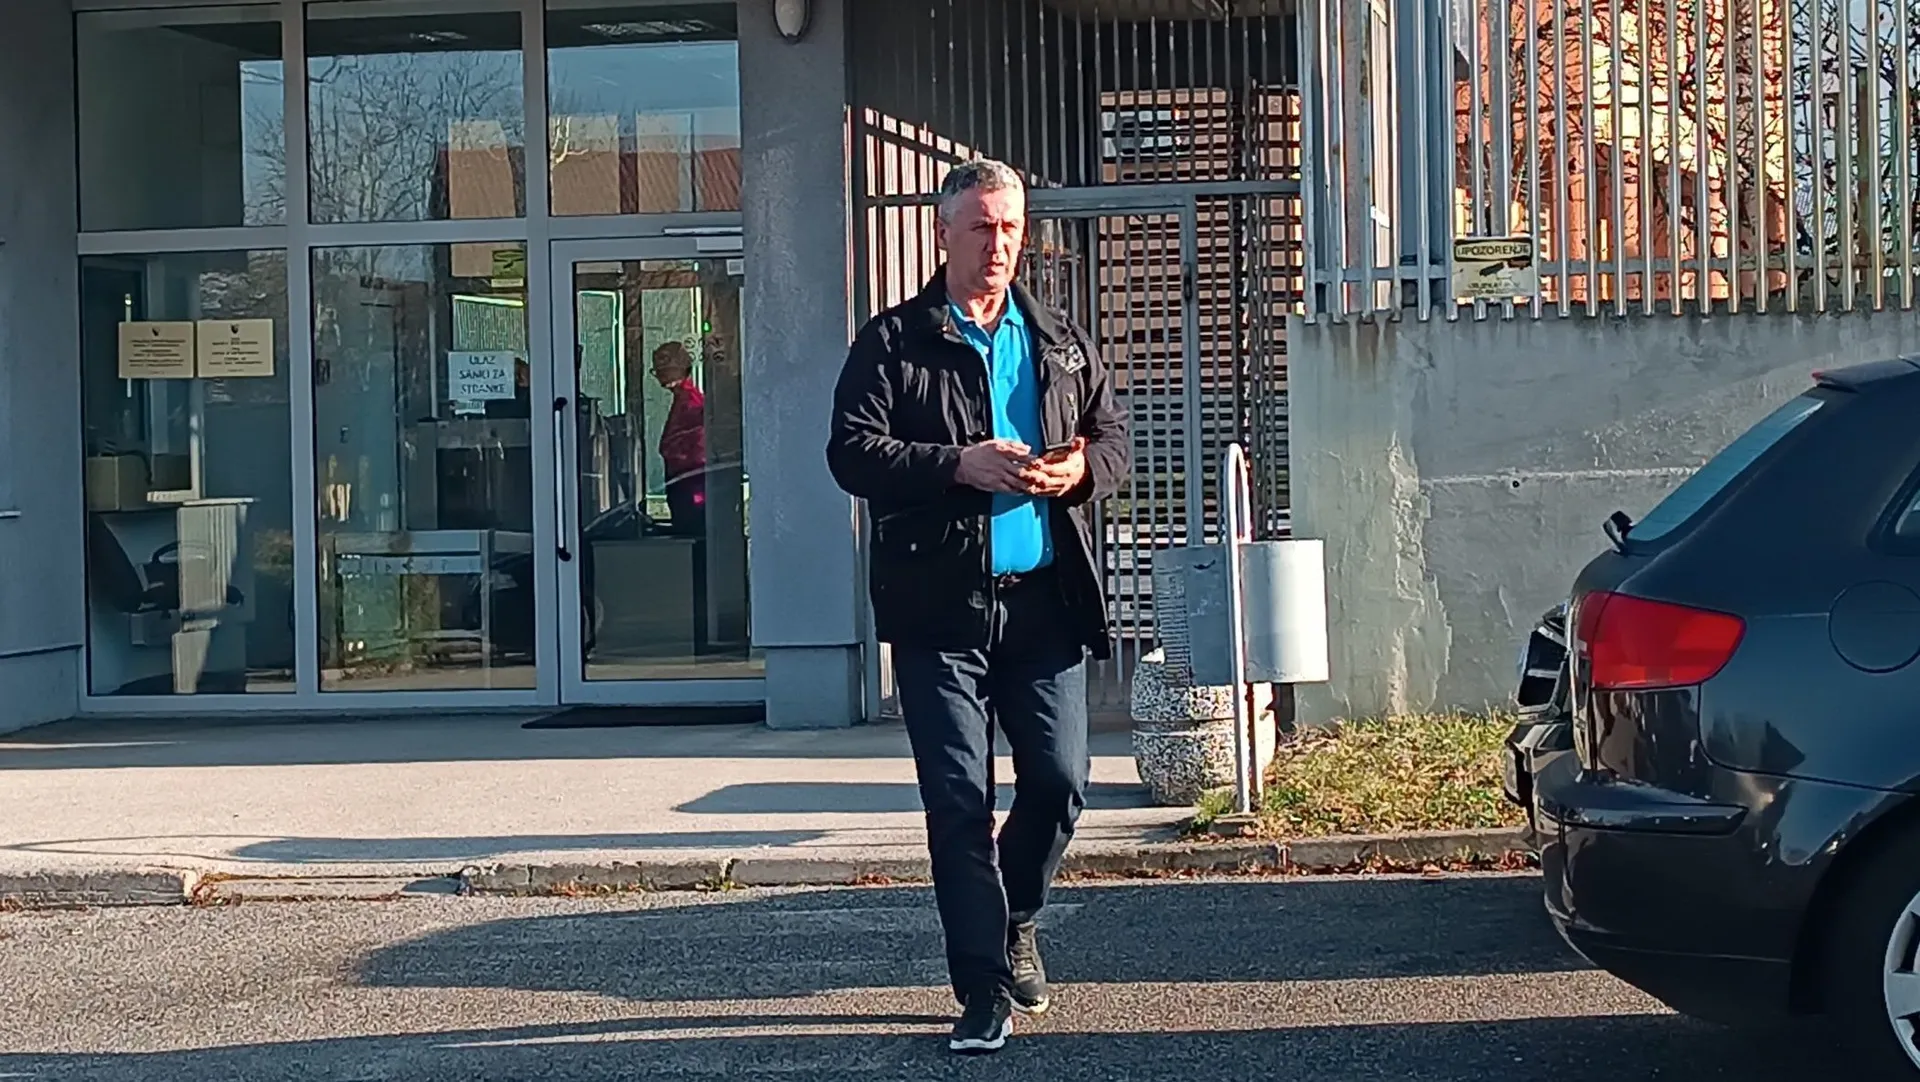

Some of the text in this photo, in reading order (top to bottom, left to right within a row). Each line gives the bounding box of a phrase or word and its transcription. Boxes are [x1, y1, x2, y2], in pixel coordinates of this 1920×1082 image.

[1457, 244, 1529, 256] UPOZORENJE
[469, 355, 496, 365] ULAZ
[493, 369, 505, 379] ZA
